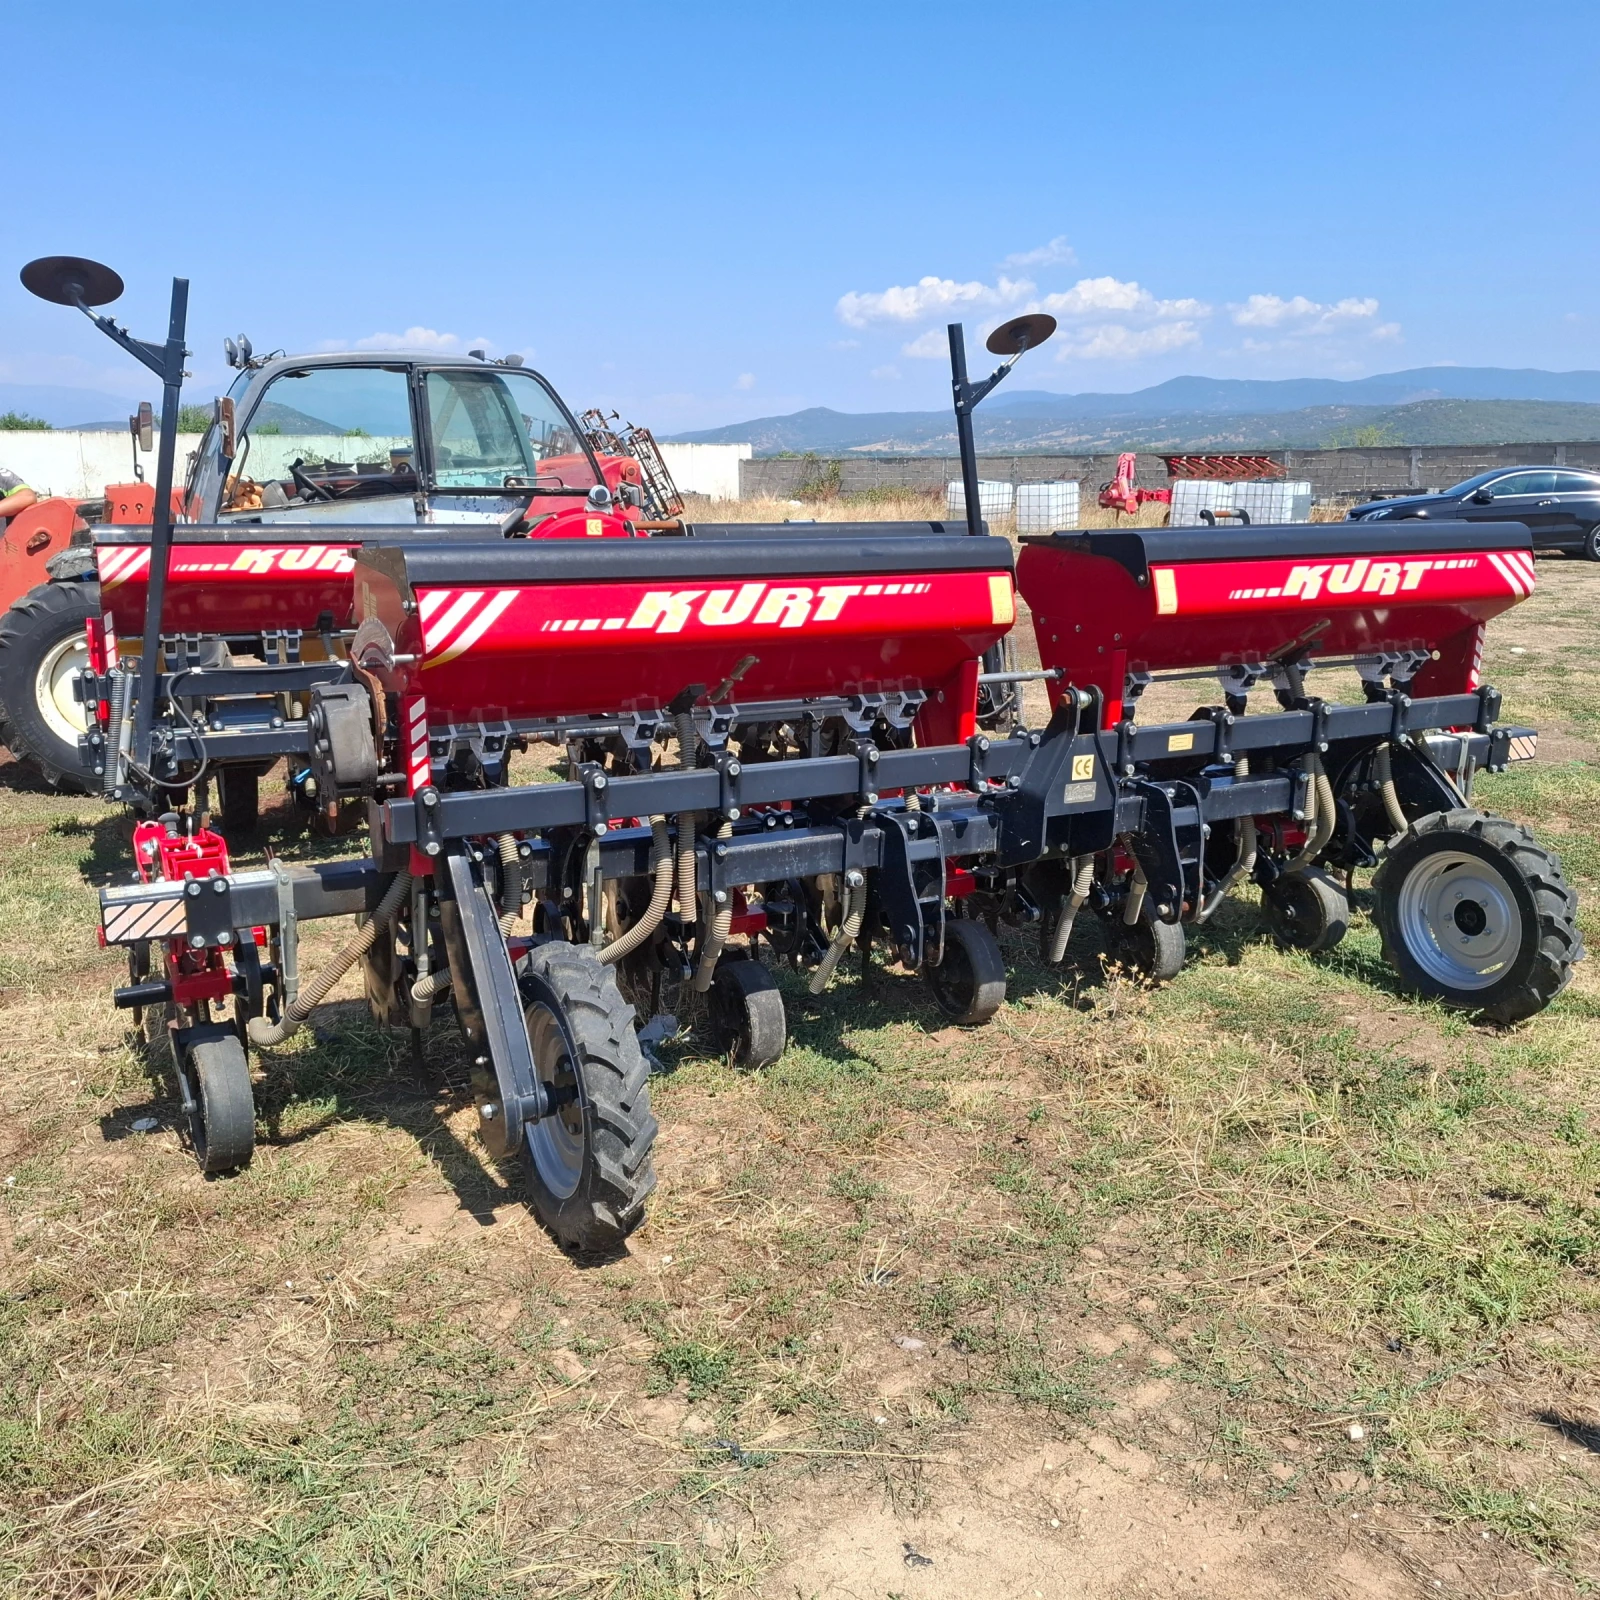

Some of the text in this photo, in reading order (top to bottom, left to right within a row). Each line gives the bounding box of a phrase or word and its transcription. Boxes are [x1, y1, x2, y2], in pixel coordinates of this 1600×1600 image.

[589, 522, 600, 532] CE
[229, 545, 357, 574] KUR
[1281, 559, 1433, 601] KURT
[626, 583, 862, 633] KURT
[1075, 759, 1091, 776] CE
